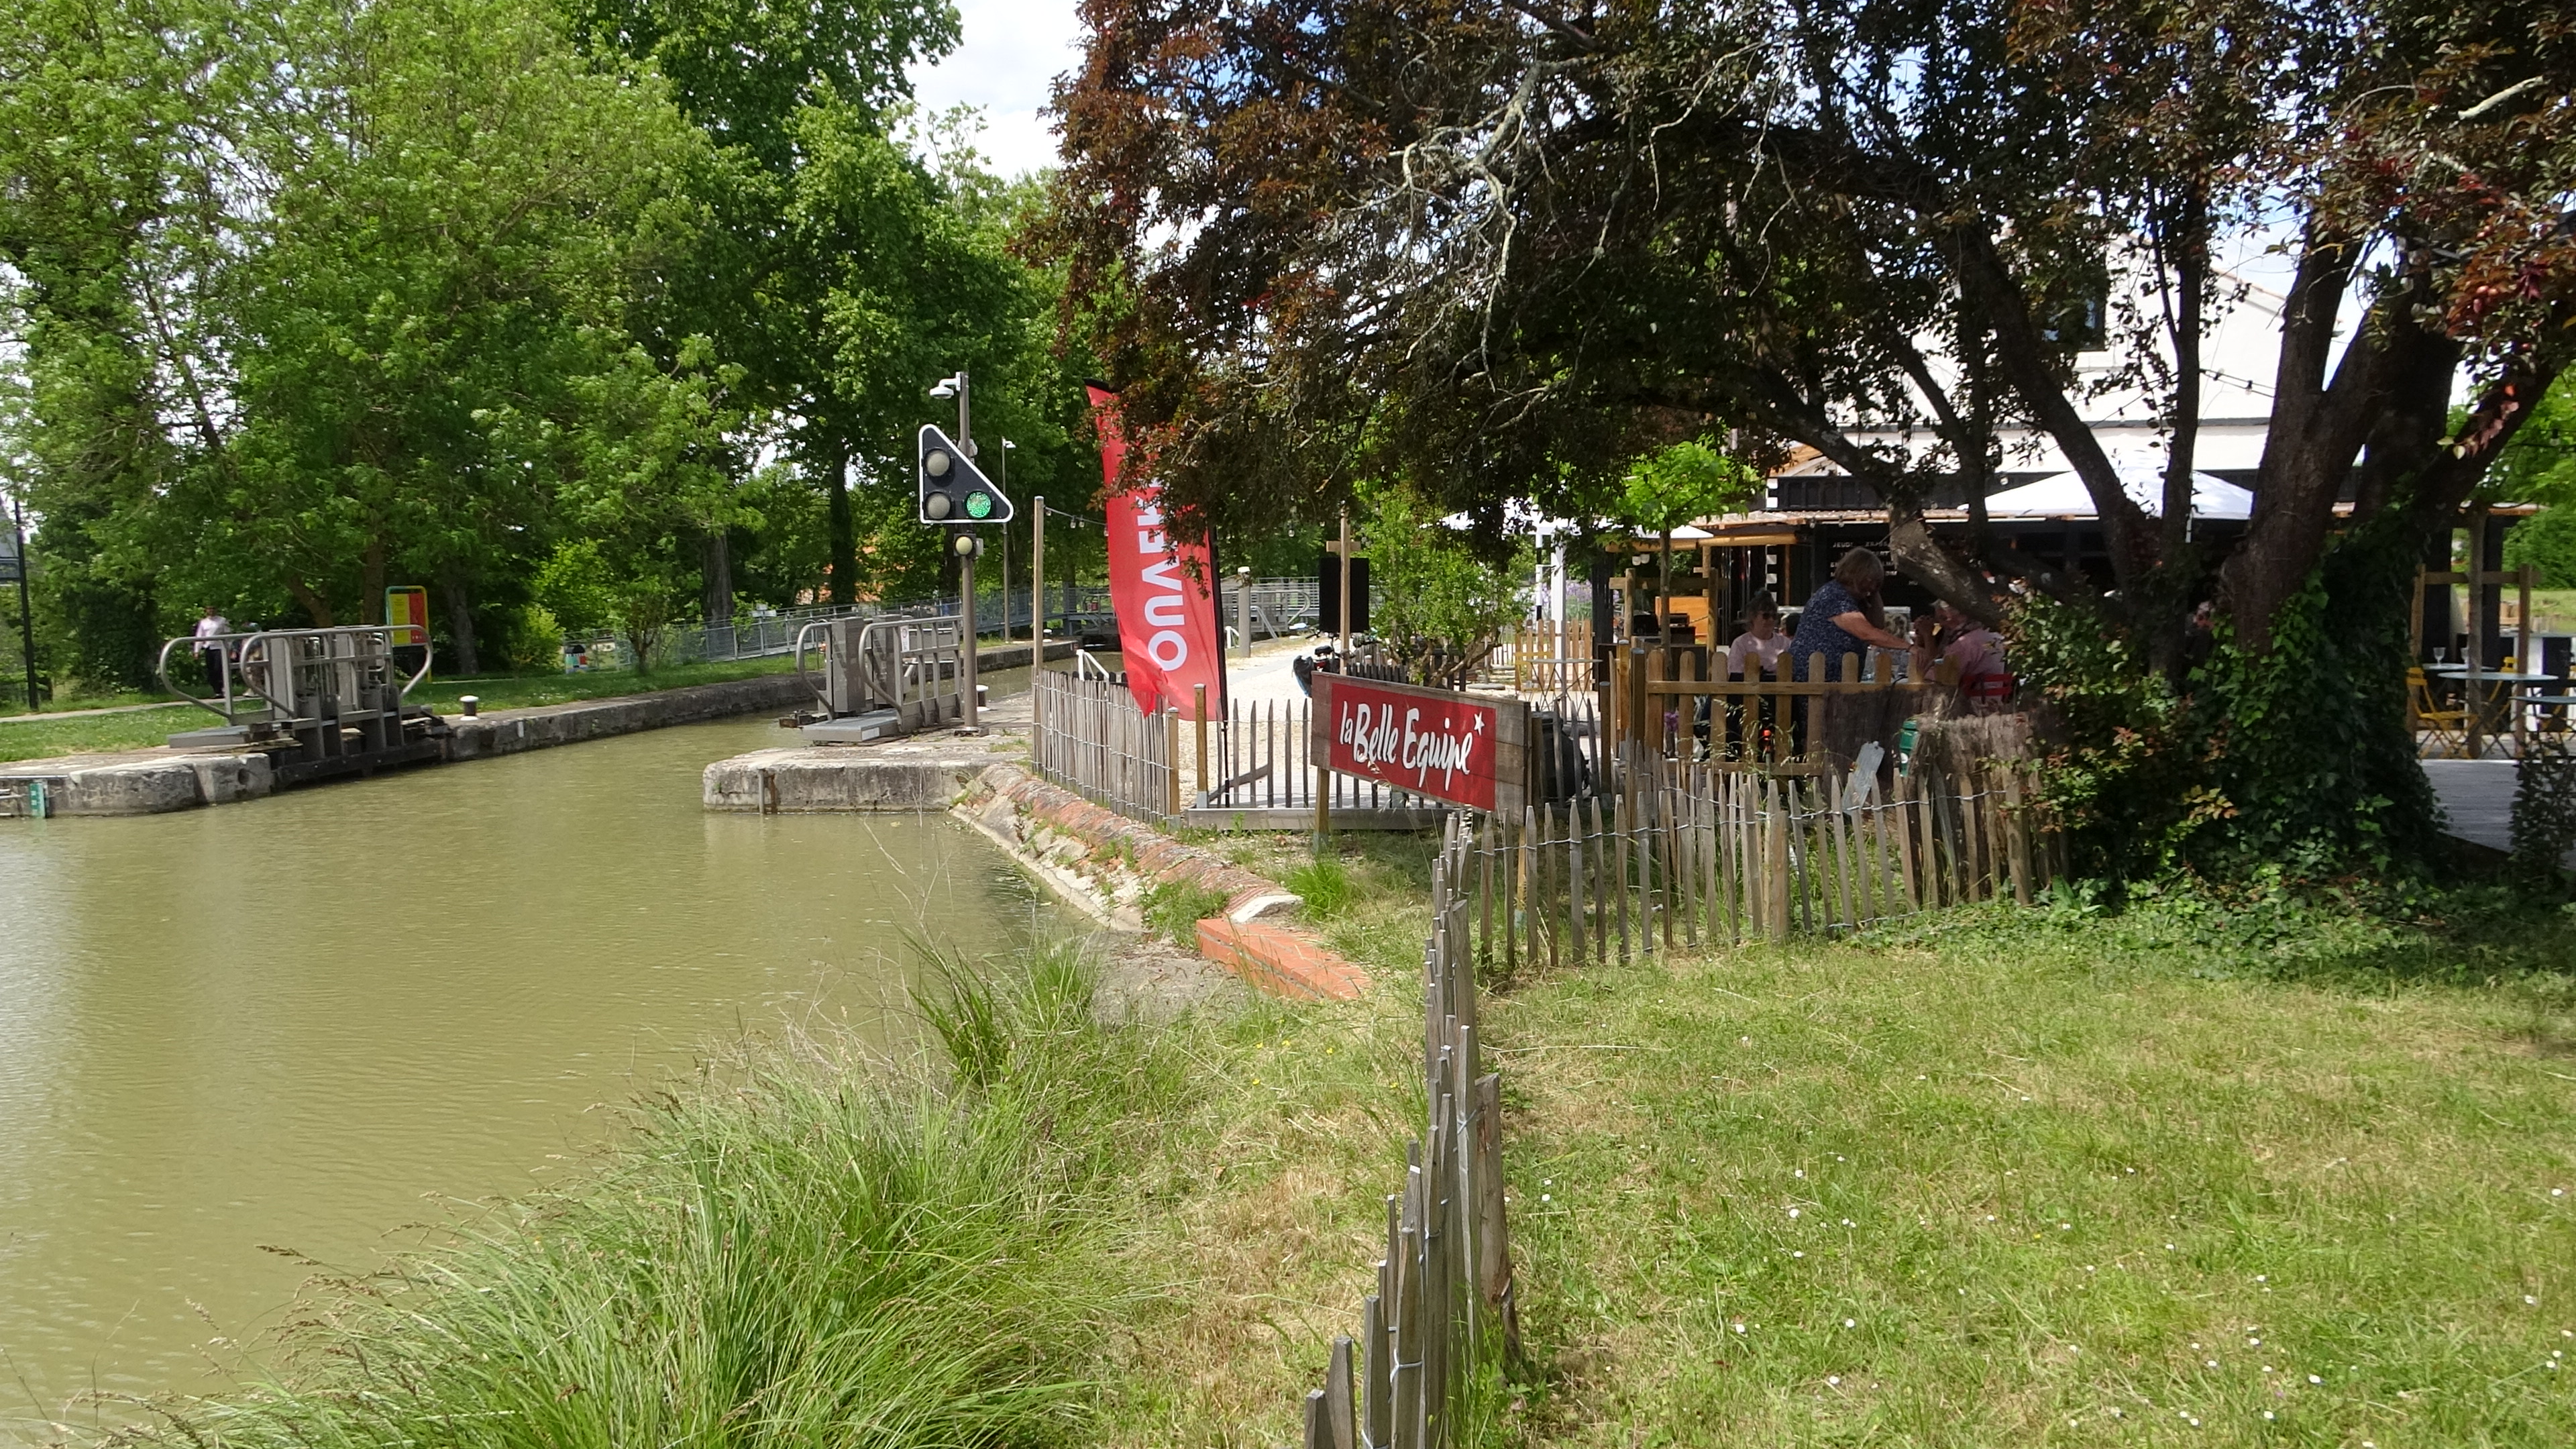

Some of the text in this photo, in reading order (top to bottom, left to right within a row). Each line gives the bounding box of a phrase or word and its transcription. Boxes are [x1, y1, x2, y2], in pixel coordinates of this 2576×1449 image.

[1340, 701, 1472, 792] la Belle Equipe
